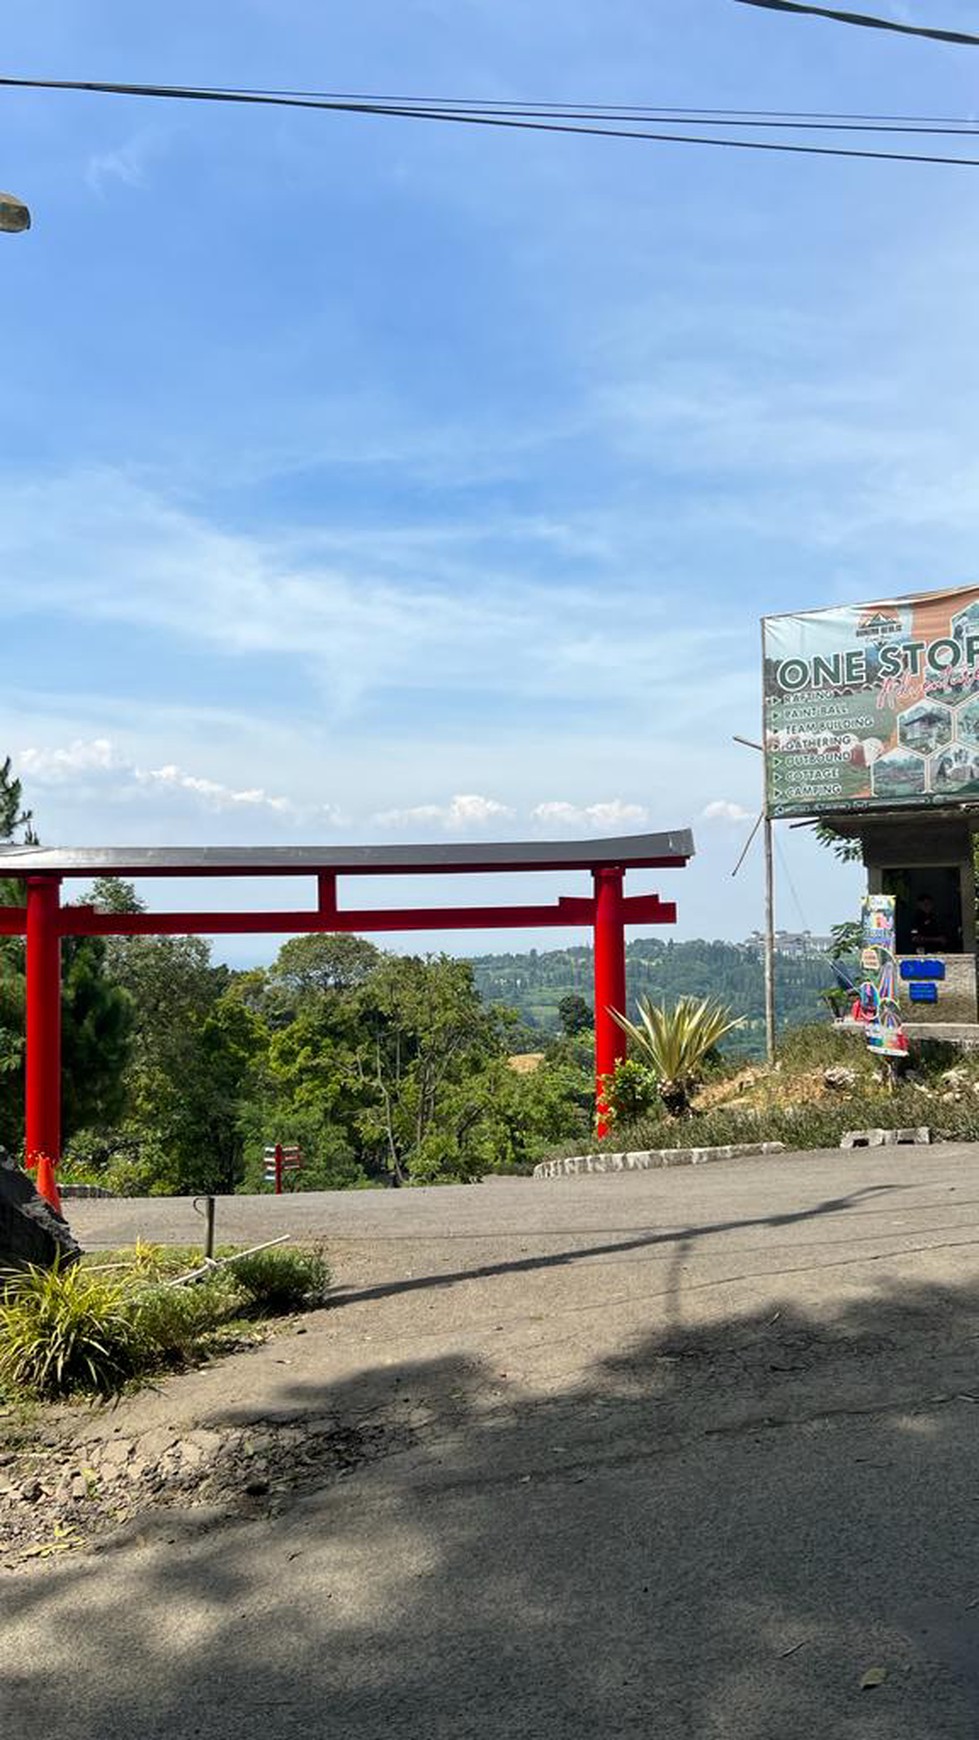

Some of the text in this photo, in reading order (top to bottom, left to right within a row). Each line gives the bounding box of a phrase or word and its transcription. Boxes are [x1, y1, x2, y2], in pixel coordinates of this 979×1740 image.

[777, 650, 867, 692] ONE
[783, 690, 832, 705] RAFTING
[784, 703, 848, 719] PAINT BALL
[785, 716, 873, 735] TEAM BUILDING
[785, 735, 851, 750] GATHERING
[785, 751, 851, 767] OUTBOUND
[785, 768, 839, 782] COTTAGE
[785, 784, 841, 798] CAMPING
